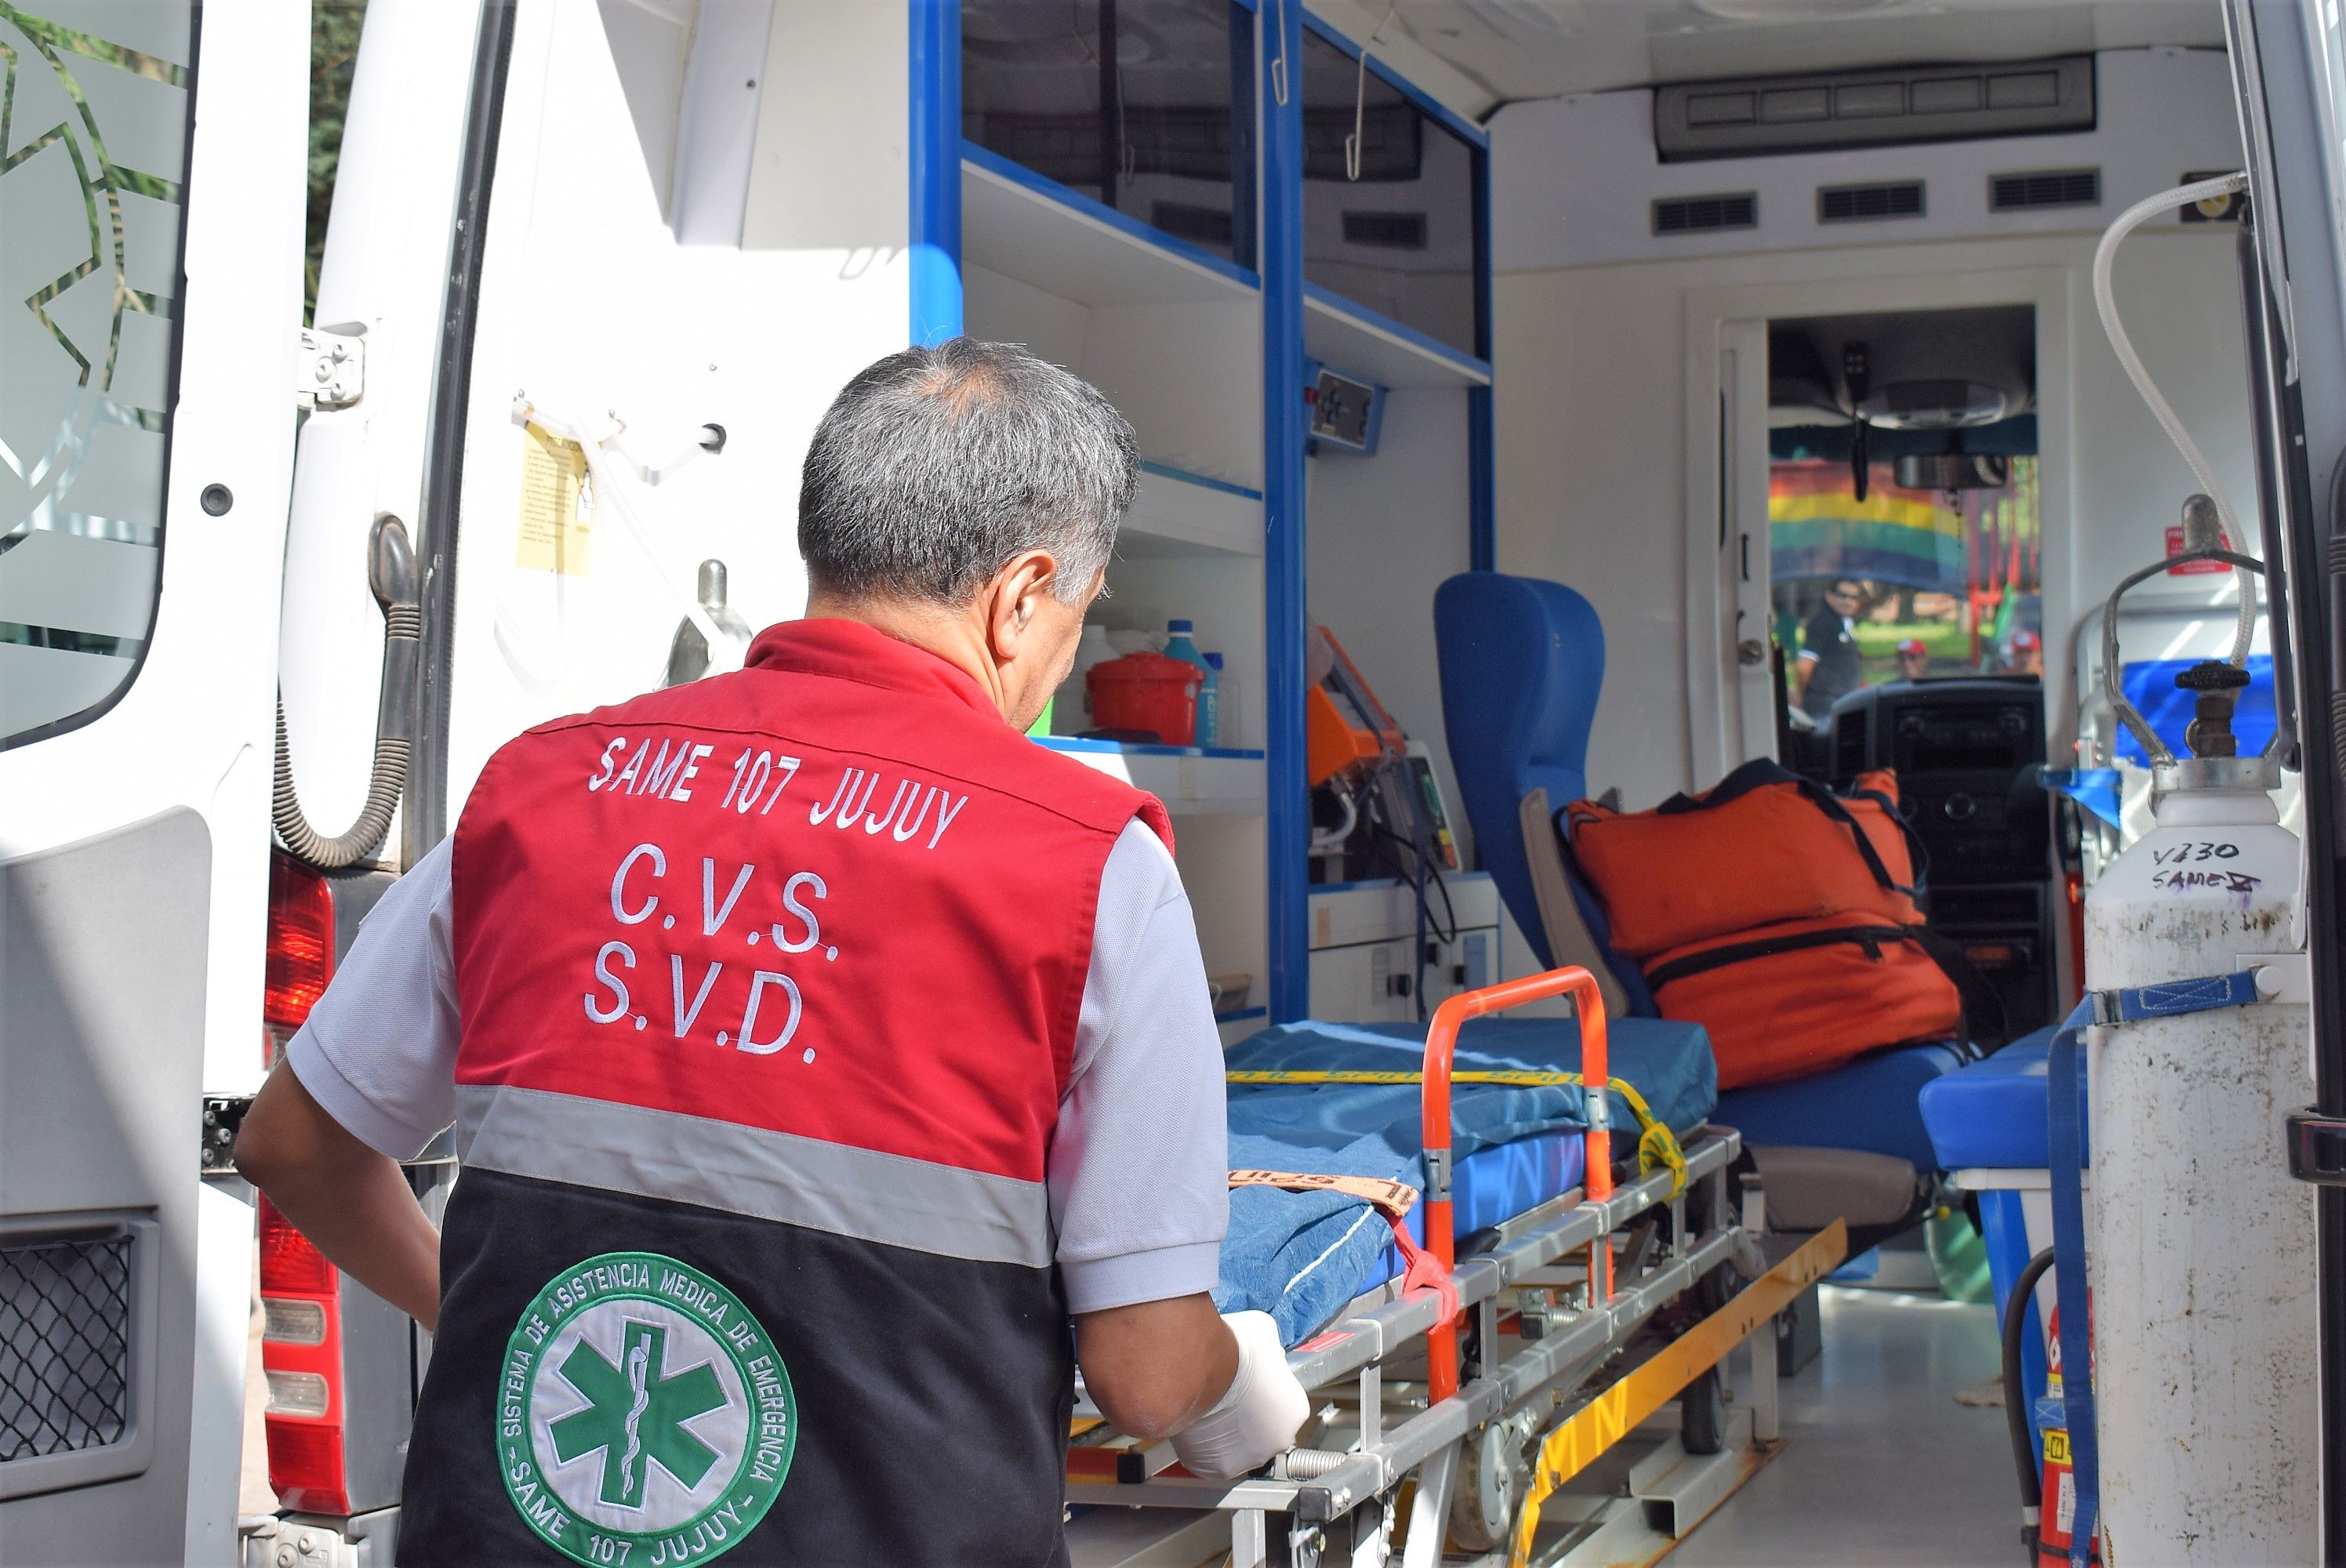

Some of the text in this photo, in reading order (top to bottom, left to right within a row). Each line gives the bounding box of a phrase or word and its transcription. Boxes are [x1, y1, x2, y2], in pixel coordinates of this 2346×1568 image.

[589, 736, 968, 850] SAME 107 JUJUY
[503, 1263, 786, 1483] SISTEMA DE ASISTENCIA MEDICA DE EMERGENCIA
[589, 1534, 633, 1566] 107
